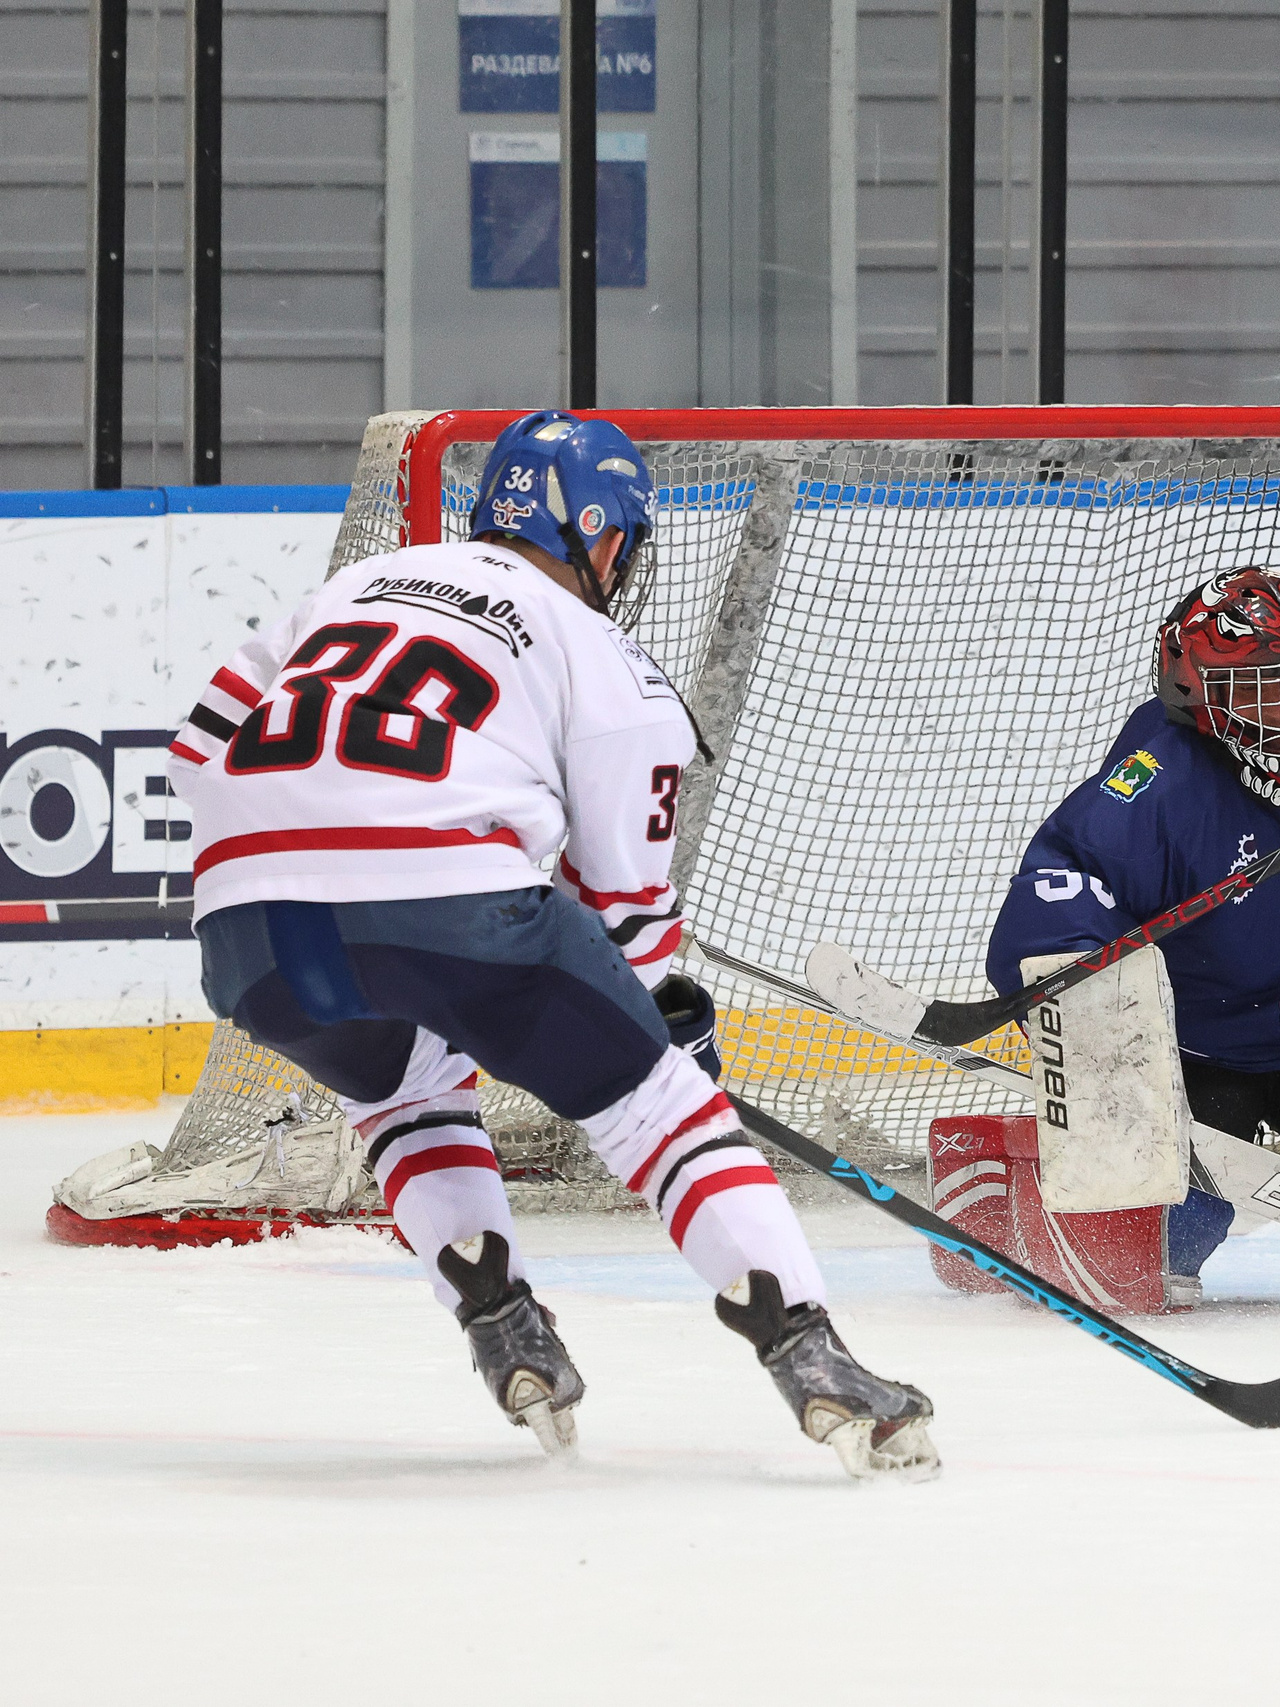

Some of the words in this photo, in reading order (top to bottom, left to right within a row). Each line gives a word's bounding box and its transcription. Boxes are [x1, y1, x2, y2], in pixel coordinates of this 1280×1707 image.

[504, 465, 533, 492] 36
[225, 620, 500, 782] 36
[1076, 872, 1254, 971] VAPOR
